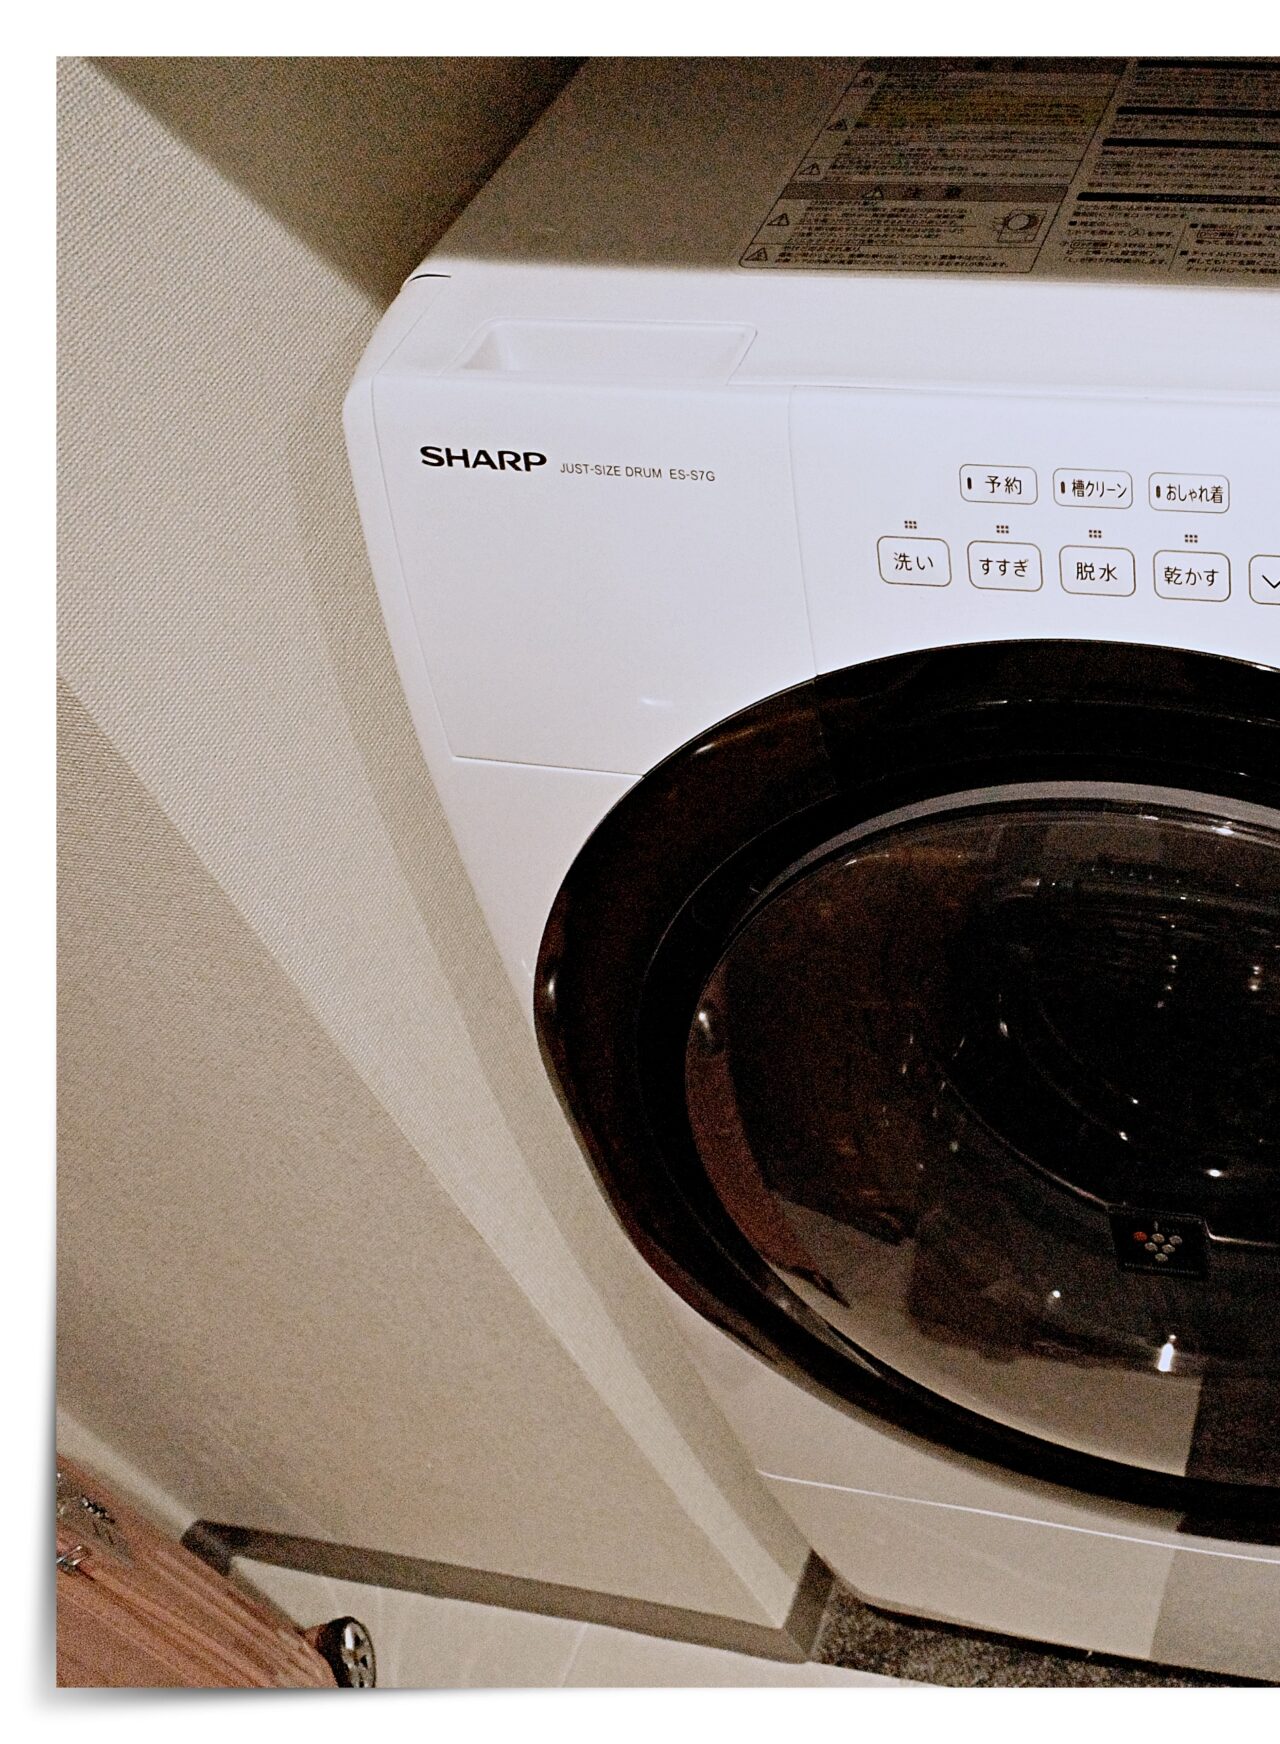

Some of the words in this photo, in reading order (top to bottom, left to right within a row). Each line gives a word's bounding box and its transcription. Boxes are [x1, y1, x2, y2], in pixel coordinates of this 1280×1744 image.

[420, 446, 548, 472] SHARP
[559, 463, 622, 477] JUST-SIZE
[625, 466, 663, 479] DRUM
[669, 468, 716, 482] ES-S7G
[984, 474, 1023, 496] 予約
[1071, 477, 1128, 500] 槽クリーン
[1165, 483, 1224, 504] おしゃれ着
[892, 551, 934, 572] 洗い
[978, 556, 1030, 578] すすぎ
[1075, 561, 1118, 583] 脱水
[1163, 565, 1220, 588] 乾かす
